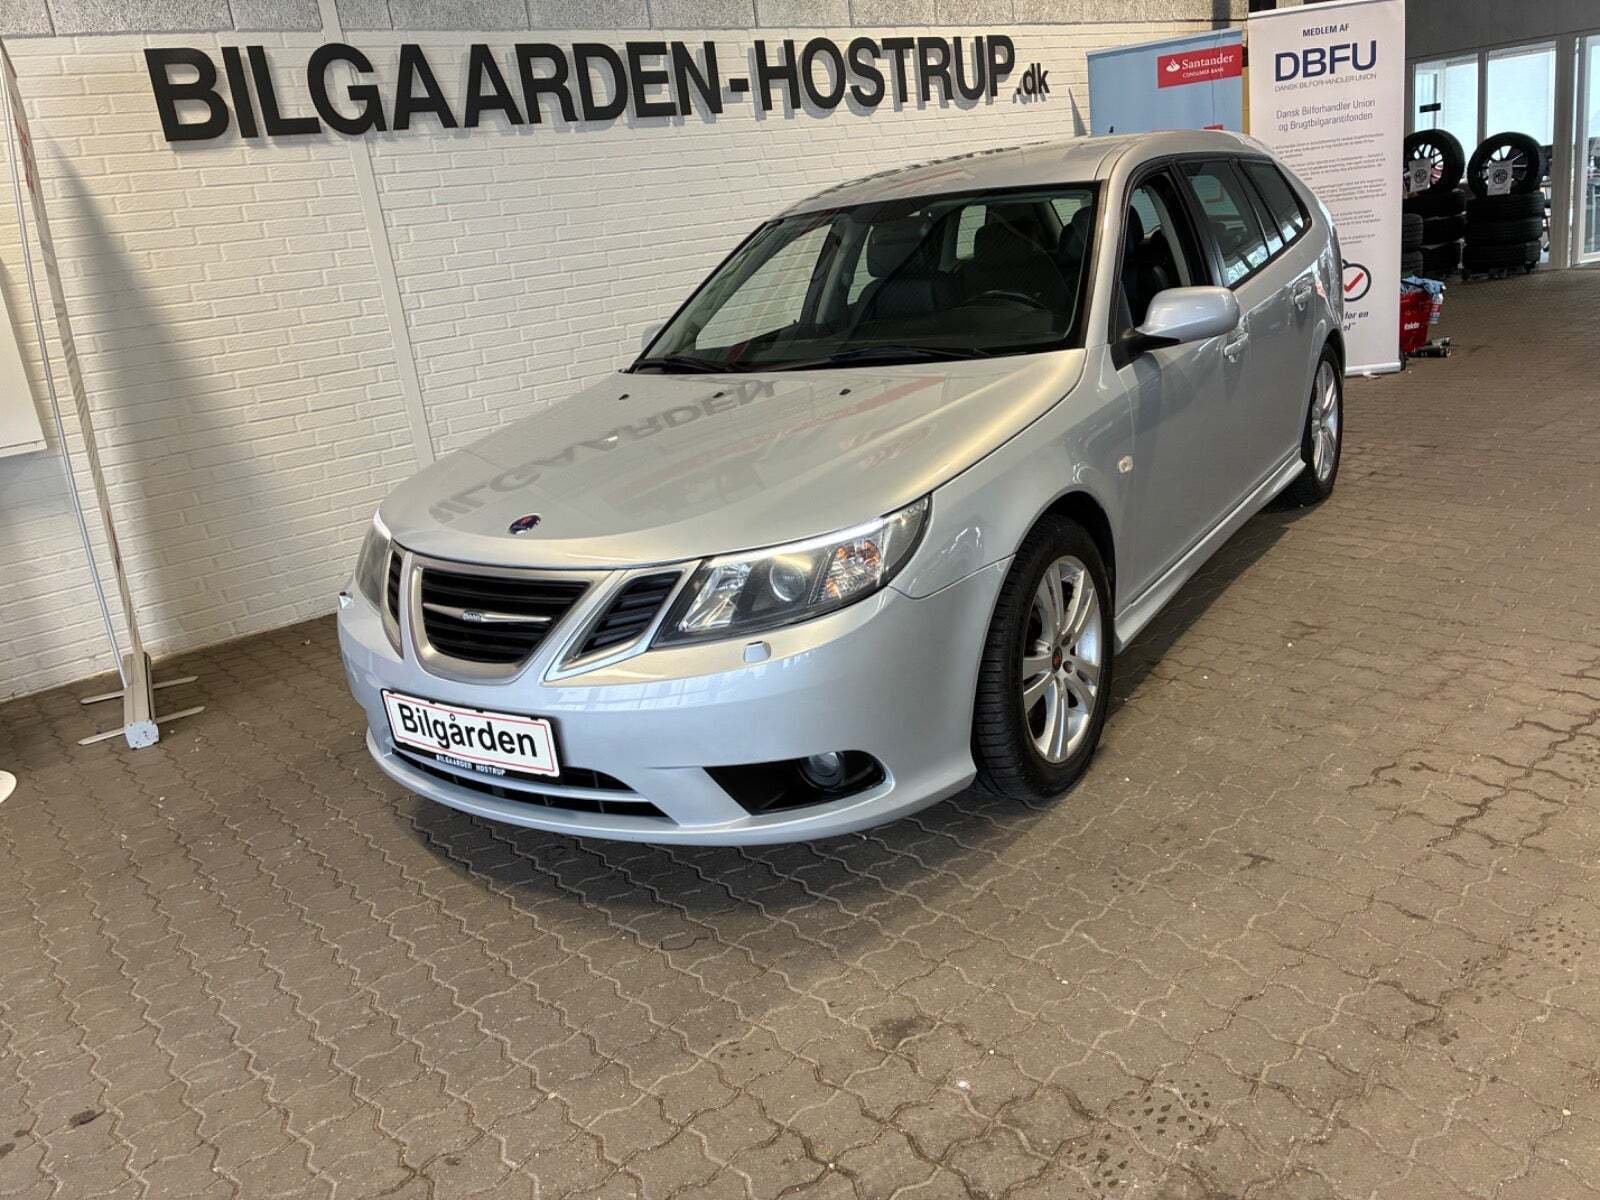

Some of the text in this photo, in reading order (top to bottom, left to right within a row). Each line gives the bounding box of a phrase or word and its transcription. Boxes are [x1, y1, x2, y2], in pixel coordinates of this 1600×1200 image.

[1303, 23, 1350, 37] MEDLEM AF
[1182, 53, 1234, 70] Santander
[1275, 40, 1377, 82] DBFU
[1274, 83, 1297, 93] DANSK
[1355, 73, 1376, 82] UNION
[1276, 99, 1375, 120] Dansk Bilforhandler Union
[1278, 112, 1373, 132] og Brugtbilgarantifonden
[398, 703, 538, 757] Bilgården
